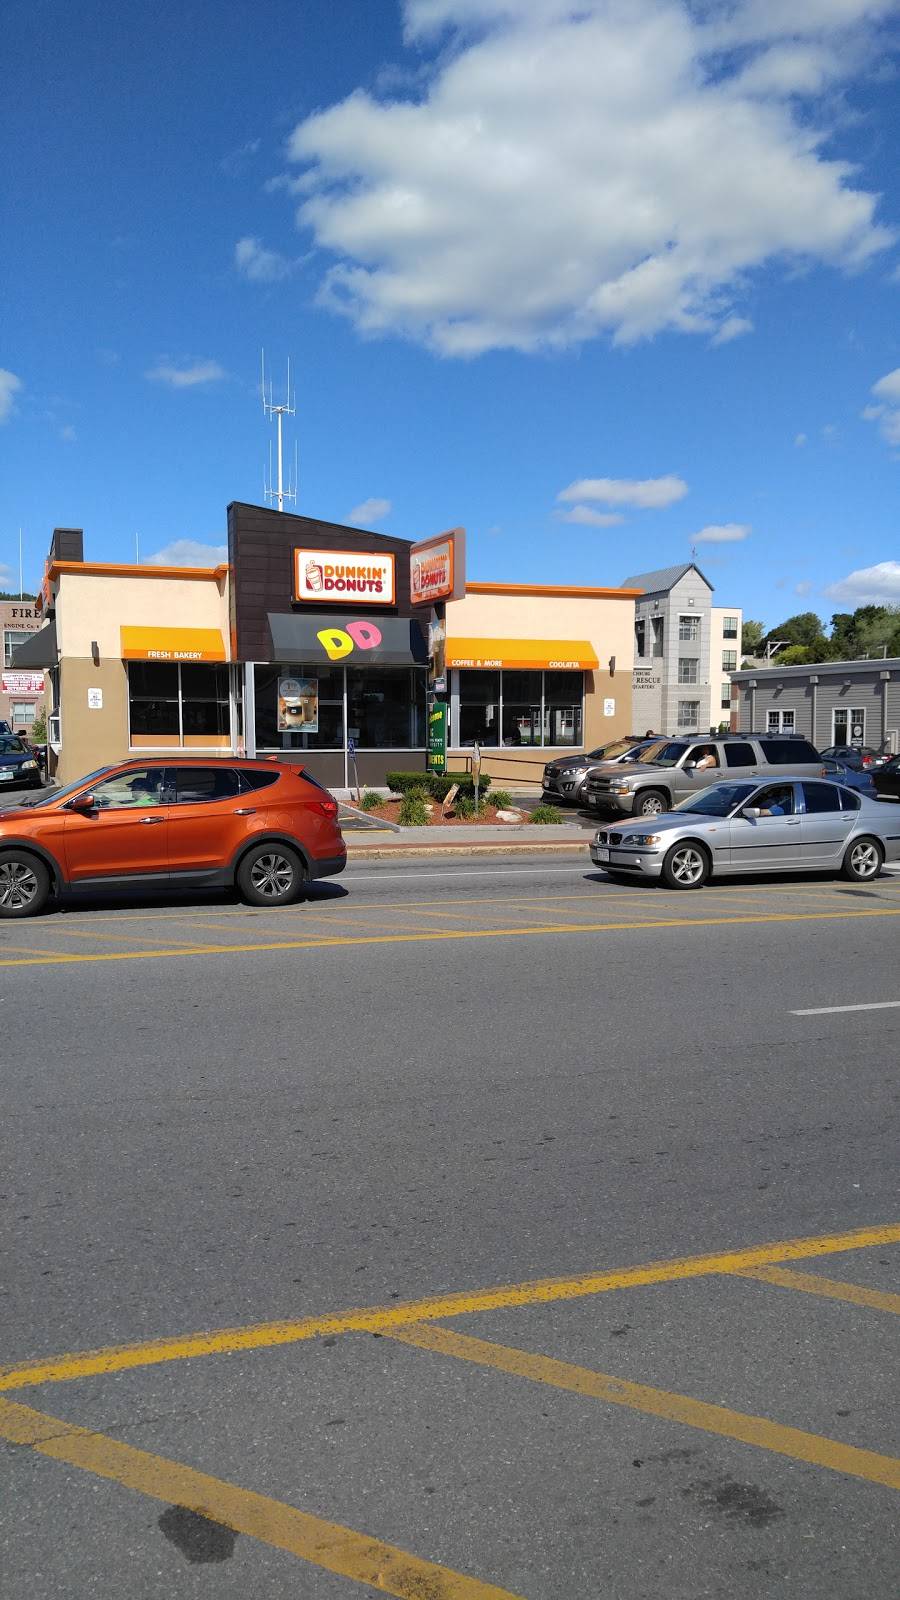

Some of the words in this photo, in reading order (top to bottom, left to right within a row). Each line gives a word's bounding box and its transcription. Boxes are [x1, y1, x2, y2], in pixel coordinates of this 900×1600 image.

[324, 565, 386, 580] DUNKIN'
[324, 579, 384, 593] DONUTS
[12, 609, 41, 618] FIRE
